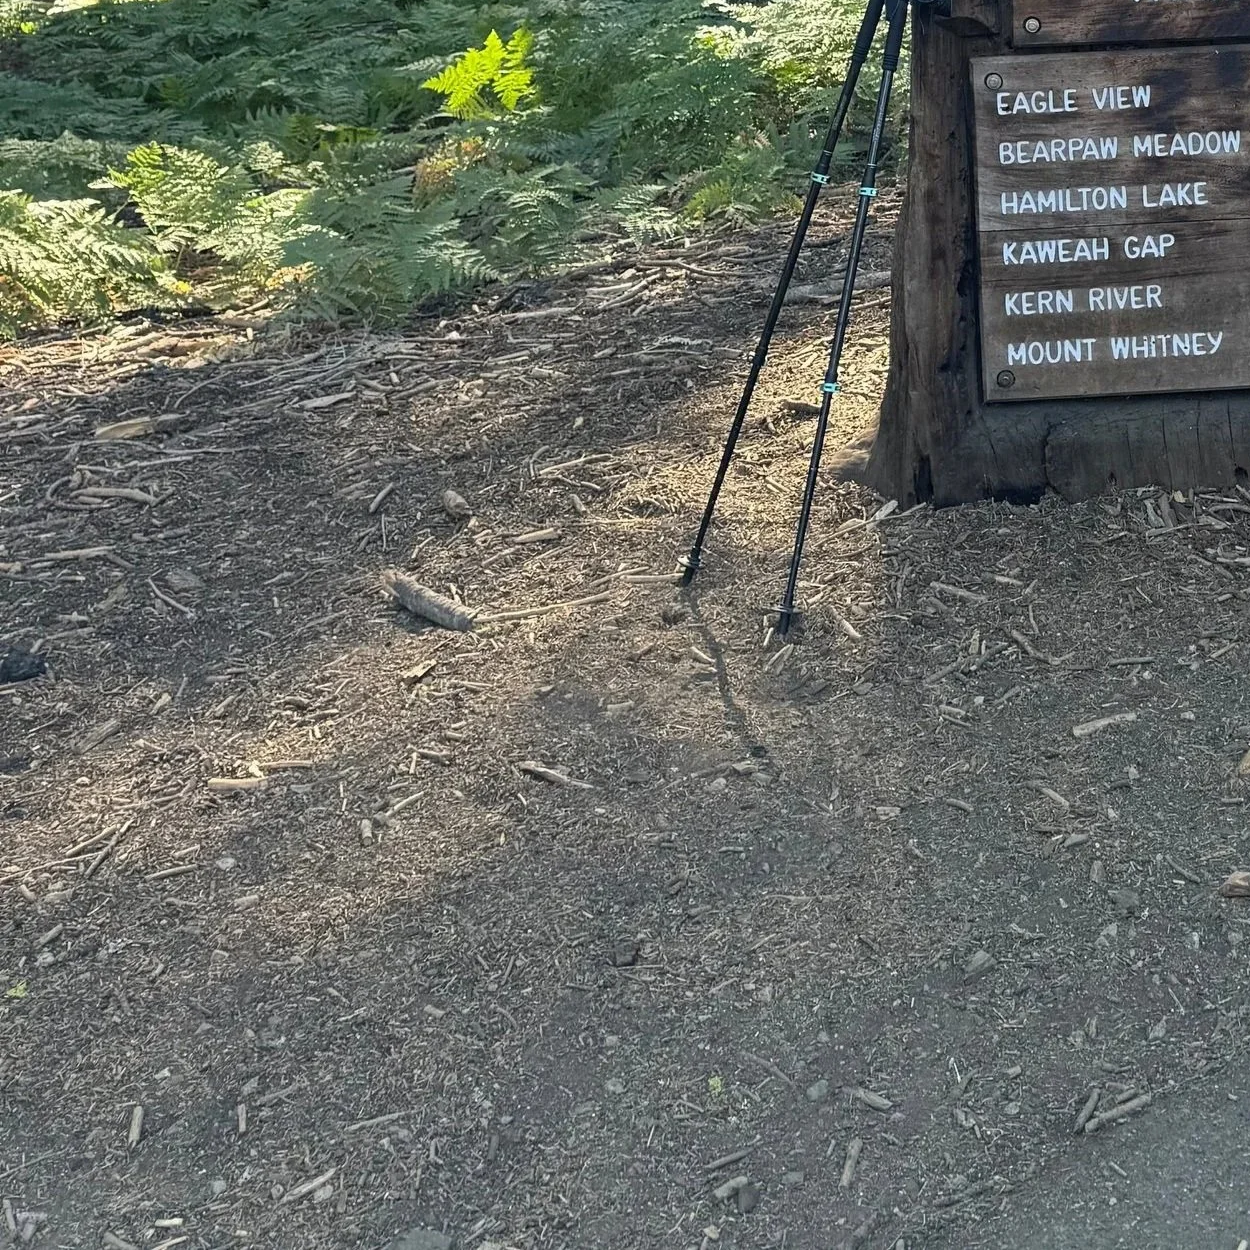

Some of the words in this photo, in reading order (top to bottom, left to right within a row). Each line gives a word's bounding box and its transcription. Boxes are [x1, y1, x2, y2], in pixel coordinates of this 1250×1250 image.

[996, 88, 1078, 116] EAGLE
[1092, 85, 1152, 110] VIEW
[999, 136, 1118, 165] BEARPAW
[1133, 130, 1241, 158] MEADOW
[1000, 185, 1127, 215] HAMILTON
[1143, 181, 1209, 208] LAKE
[1002, 237, 1110, 266] KAWEAH
[1124, 233, 1176, 260] GAP
[1004, 289, 1073, 316] KERN
[1089, 285, 1163, 311] RIVER
[1007, 338, 1096, 366] MOUNT
